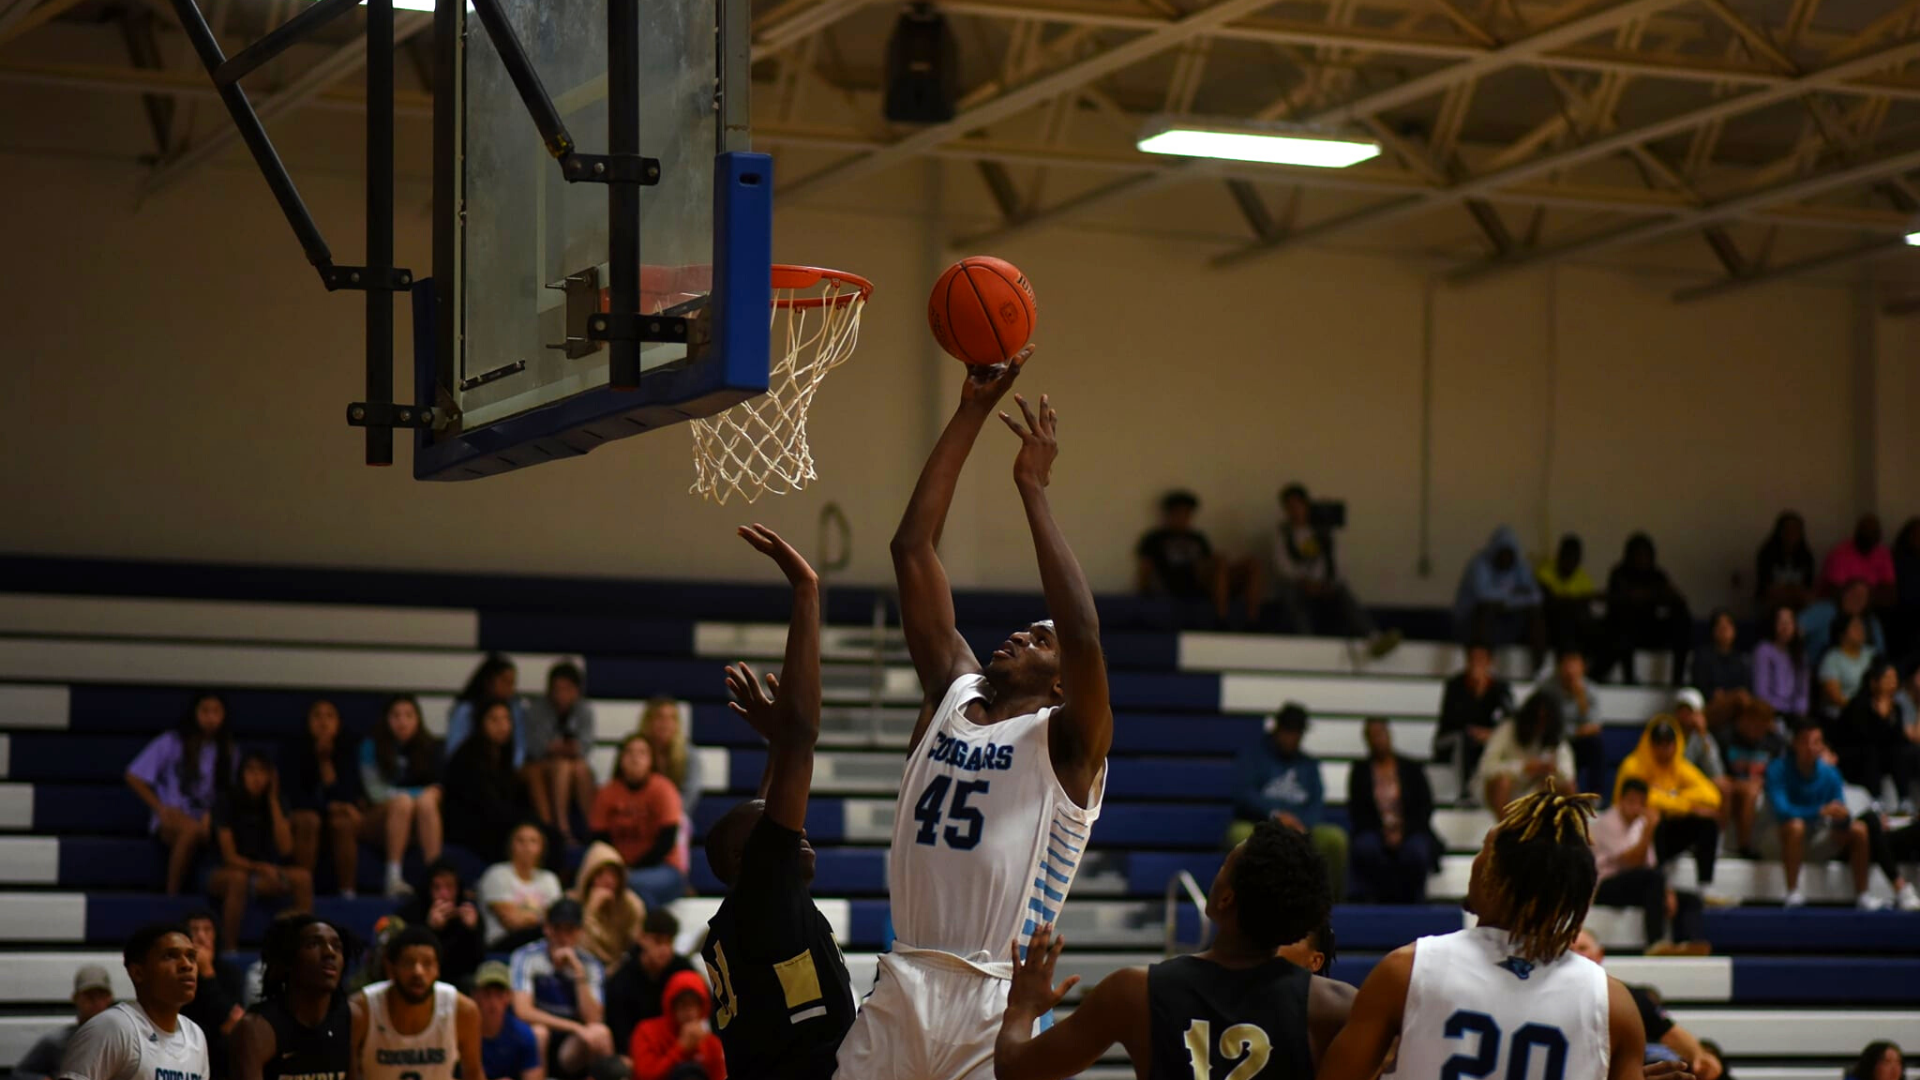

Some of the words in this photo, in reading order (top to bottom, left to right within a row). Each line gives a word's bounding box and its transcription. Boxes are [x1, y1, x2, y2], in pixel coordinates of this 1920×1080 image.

[915, 774, 990, 851] 45
[376, 1047, 446, 1065] COUGARS
[1183, 1018, 1274, 1080] 12
[1441, 1008, 1569, 1080] 20
